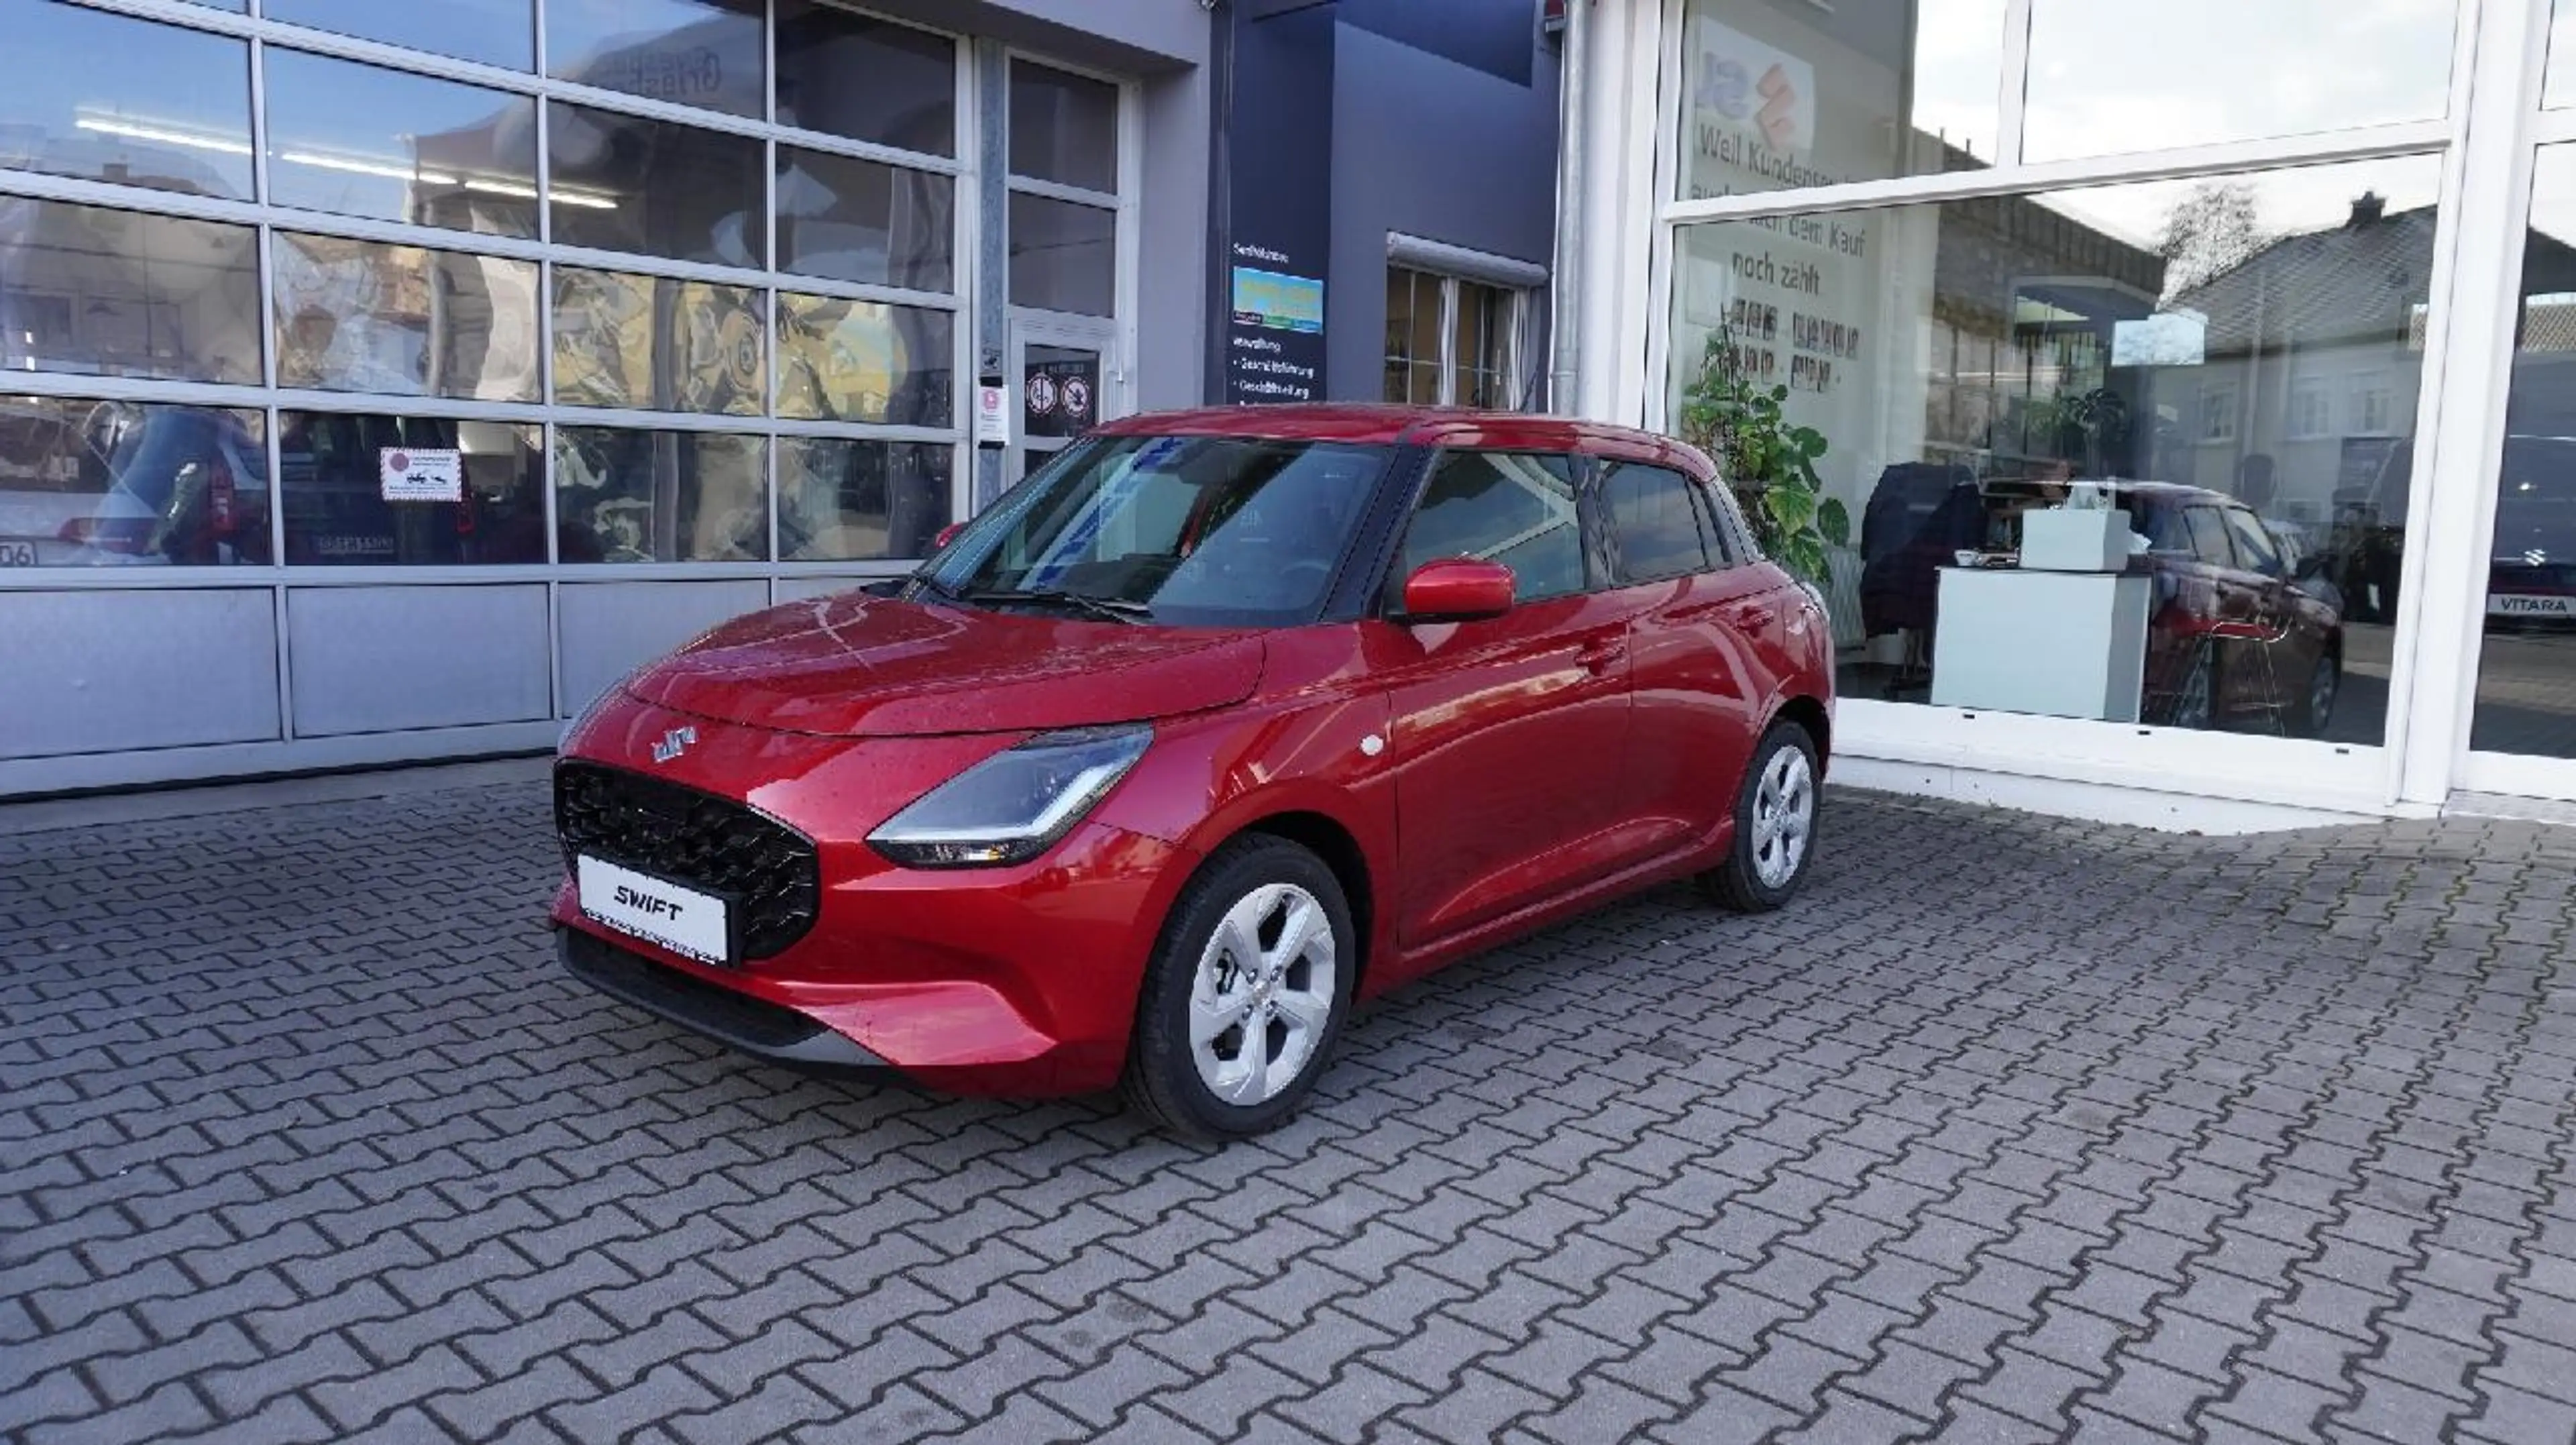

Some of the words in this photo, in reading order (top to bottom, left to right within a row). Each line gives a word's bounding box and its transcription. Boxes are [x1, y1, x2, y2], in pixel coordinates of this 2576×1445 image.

[1700, 123, 1741, 166] Weil
[1732, 250, 1774, 284] noch
[2501, 597, 2567, 612] VITARA
[613, 885, 684, 921] SWIFT
